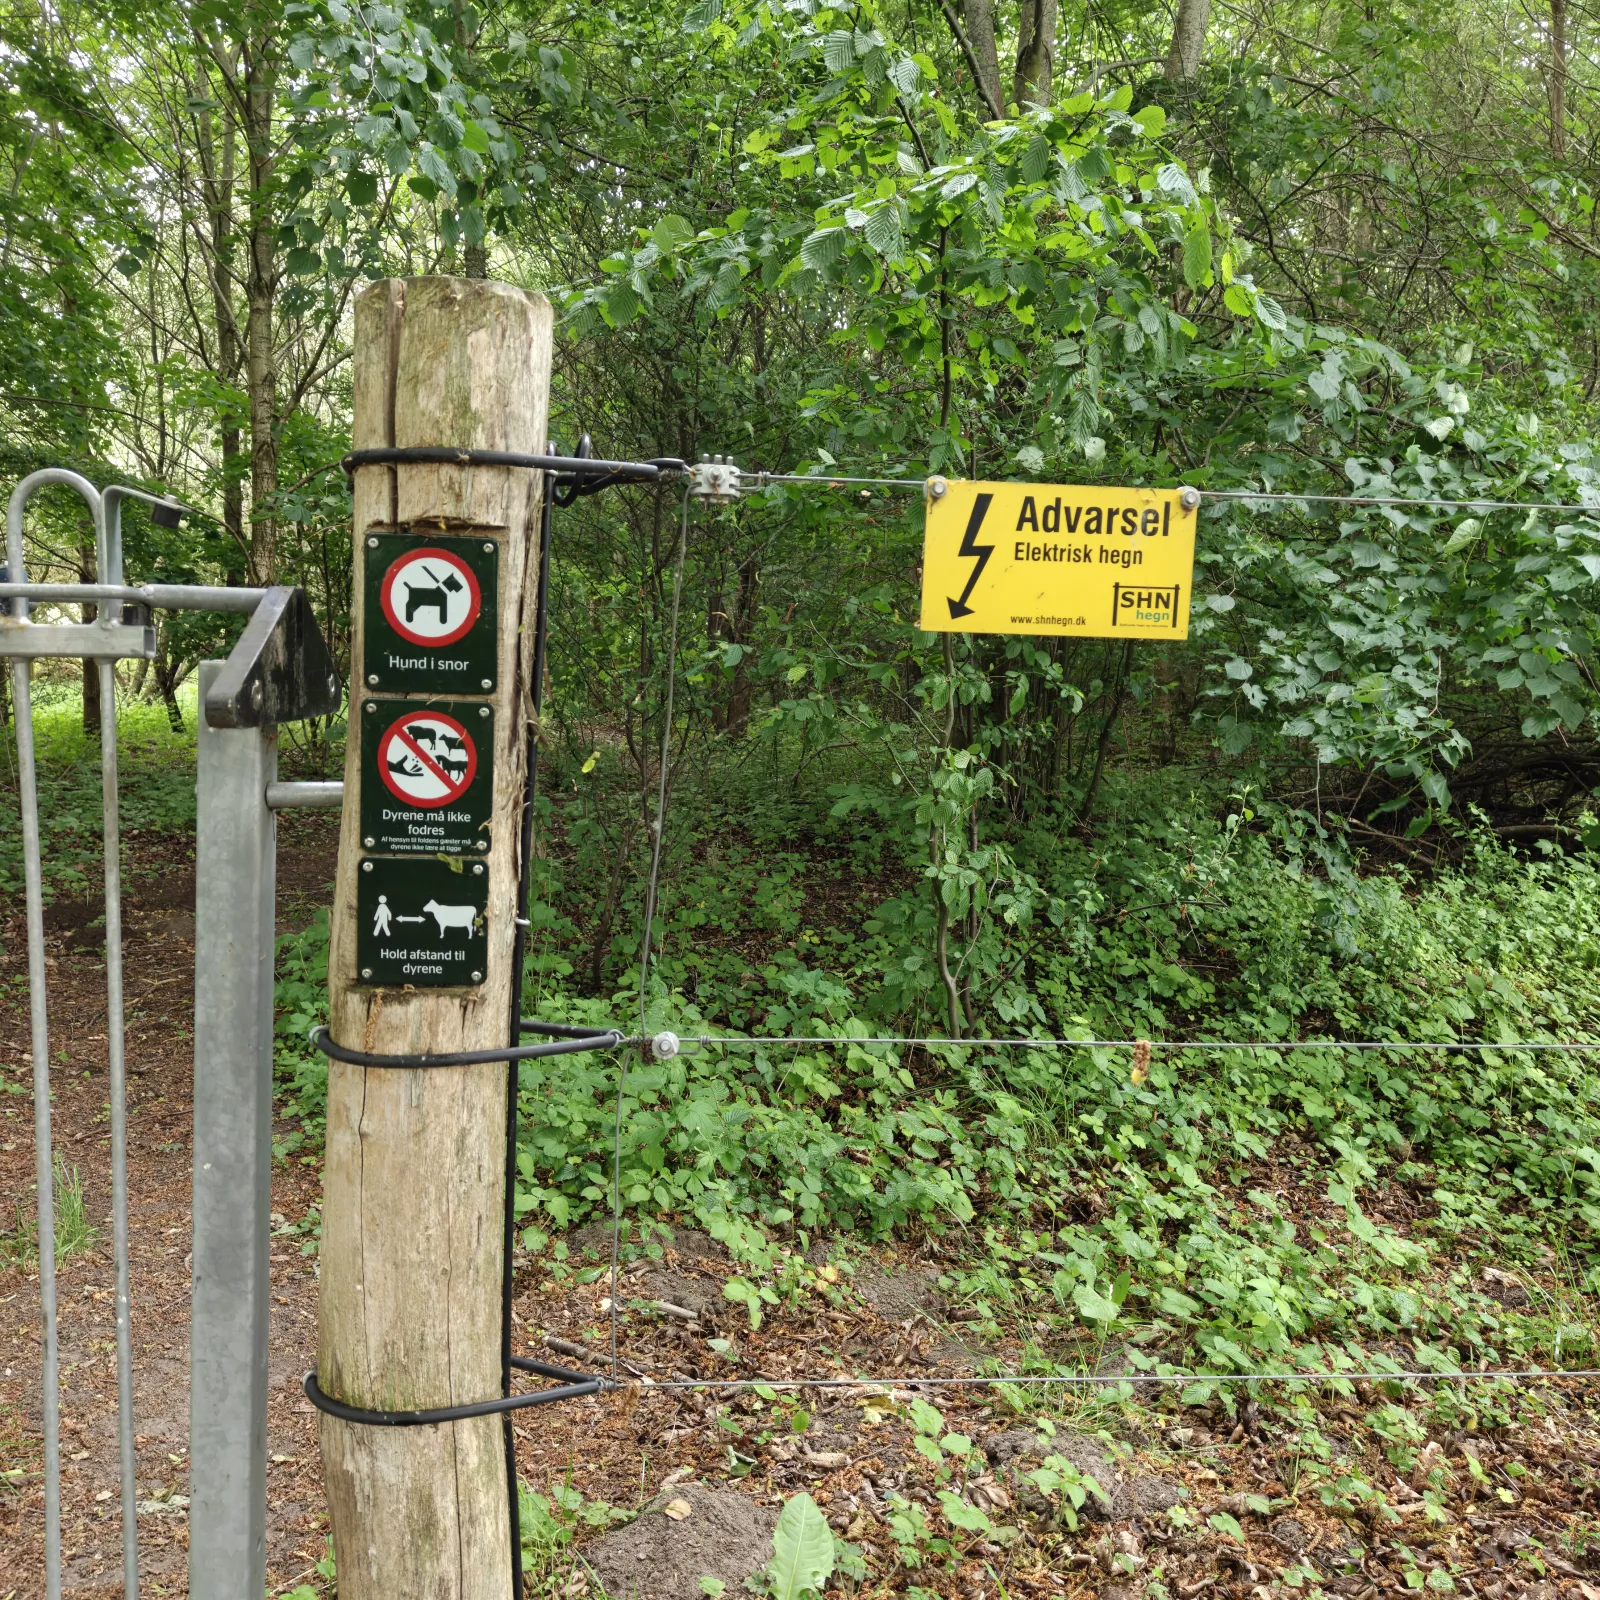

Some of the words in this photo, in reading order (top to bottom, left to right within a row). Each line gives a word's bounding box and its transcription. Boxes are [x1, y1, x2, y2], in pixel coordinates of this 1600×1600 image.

[1015, 495, 1171, 537] Advarsel
[1014, 542, 1092, 563] Elektrisk
[1099, 546, 1143, 568] hegn
[1120, 591, 1171, 610] SHN
[1010, 614, 1087, 627] www.shnhegn.dk
[1136, 609, 1170, 622] hegn
[389, 655, 427, 669] Hund
[430, 657, 434, 670] i
[438, 660, 470, 671] snor
[382, 809, 424, 822] Dyrene
[426, 811, 445, 821] må
[447, 812, 472, 822] ikke
[408, 824, 445, 836] fodres
[380, 948, 407, 960] Hold
[410, 950, 452, 960] afstand
[454, 950, 465, 960] til
[402, 963, 442, 975] dyrene
